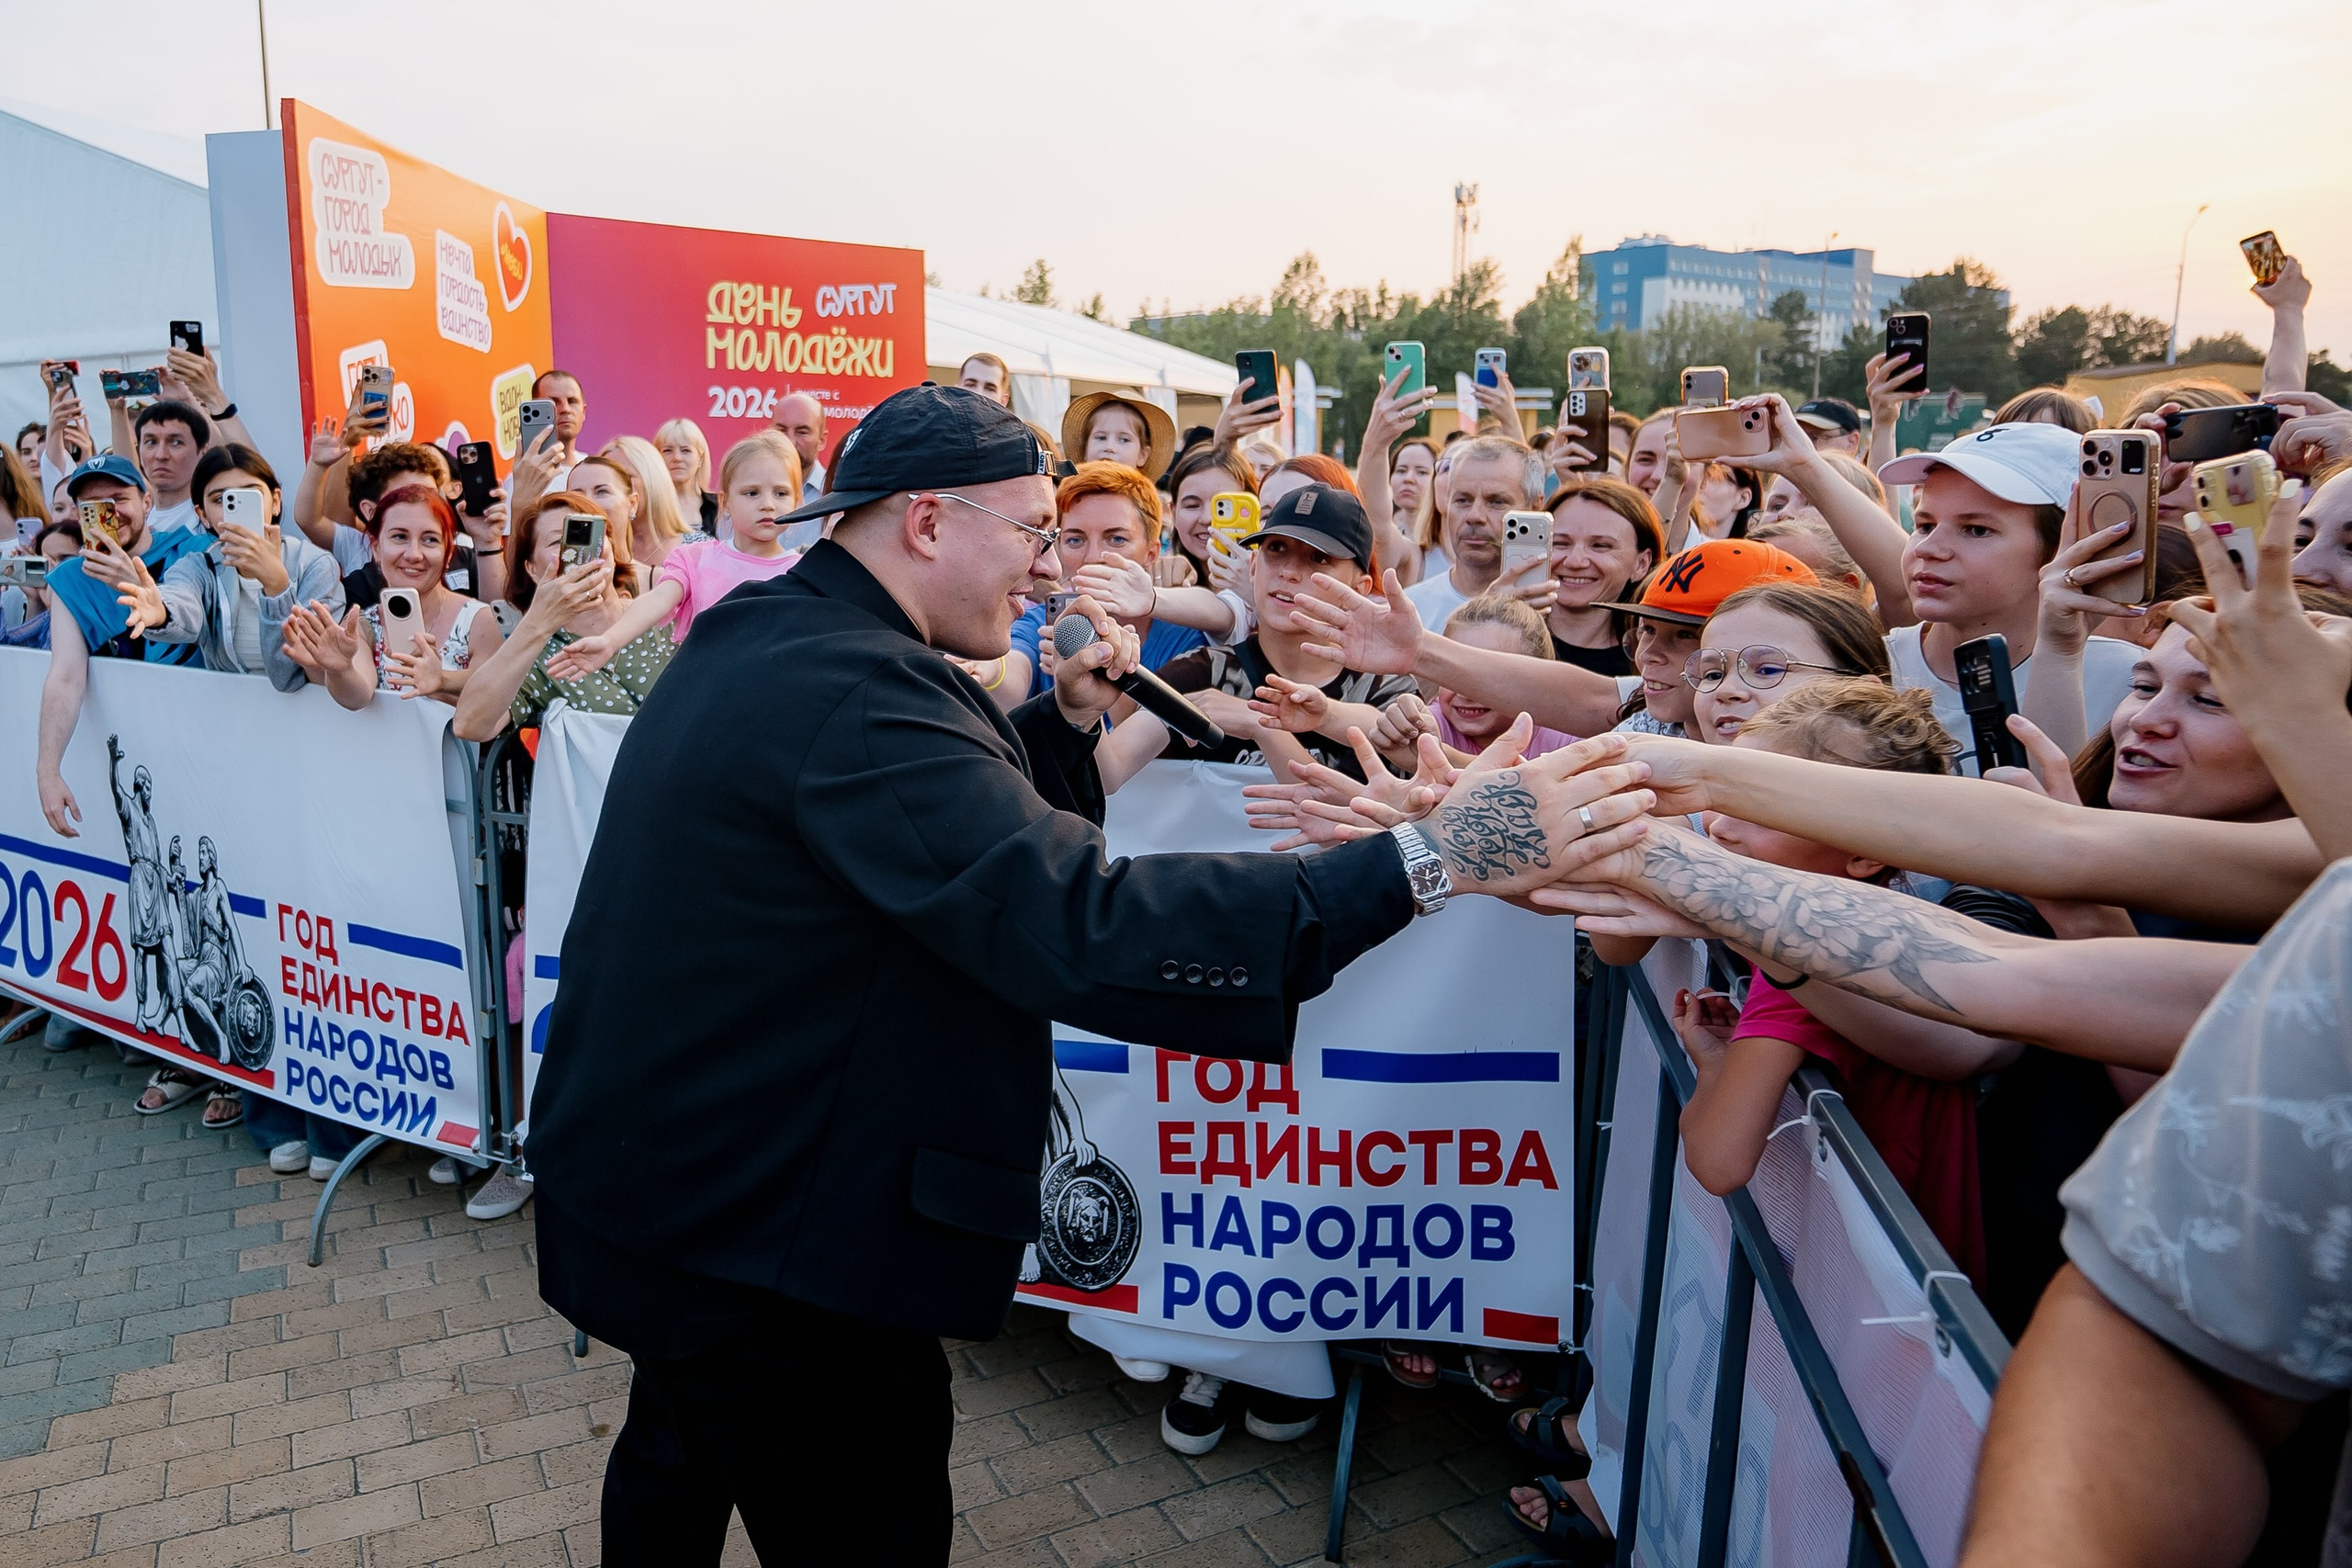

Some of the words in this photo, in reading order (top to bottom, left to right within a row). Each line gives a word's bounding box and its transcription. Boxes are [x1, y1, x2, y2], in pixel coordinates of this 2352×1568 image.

[323, 196, 372, 236] ГОРОД
[328, 238, 402, 277] МОЛОДЫХ
[816, 284, 898, 318] СУРГУТ
[707, 386, 779, 419] 2026
[0, 861, 128, 1002] 2026
[277, 903, 340, 967] ГОД
[280, 955, 470, 1046] ЕДИНСТВА
[283, 1007, 455, 1090] НАРОДОВ
[1154, 1047, 1300, 1115] ГОД
[286, 1056, 437, 1137] РОССИИ
[1158, 1121, 1560, 1190] ЕДИНСТВА
[1160, 1192, 1516, 1269] НАРОДОВ
[1163, 1262, 1464, 1334] РОССИИ
